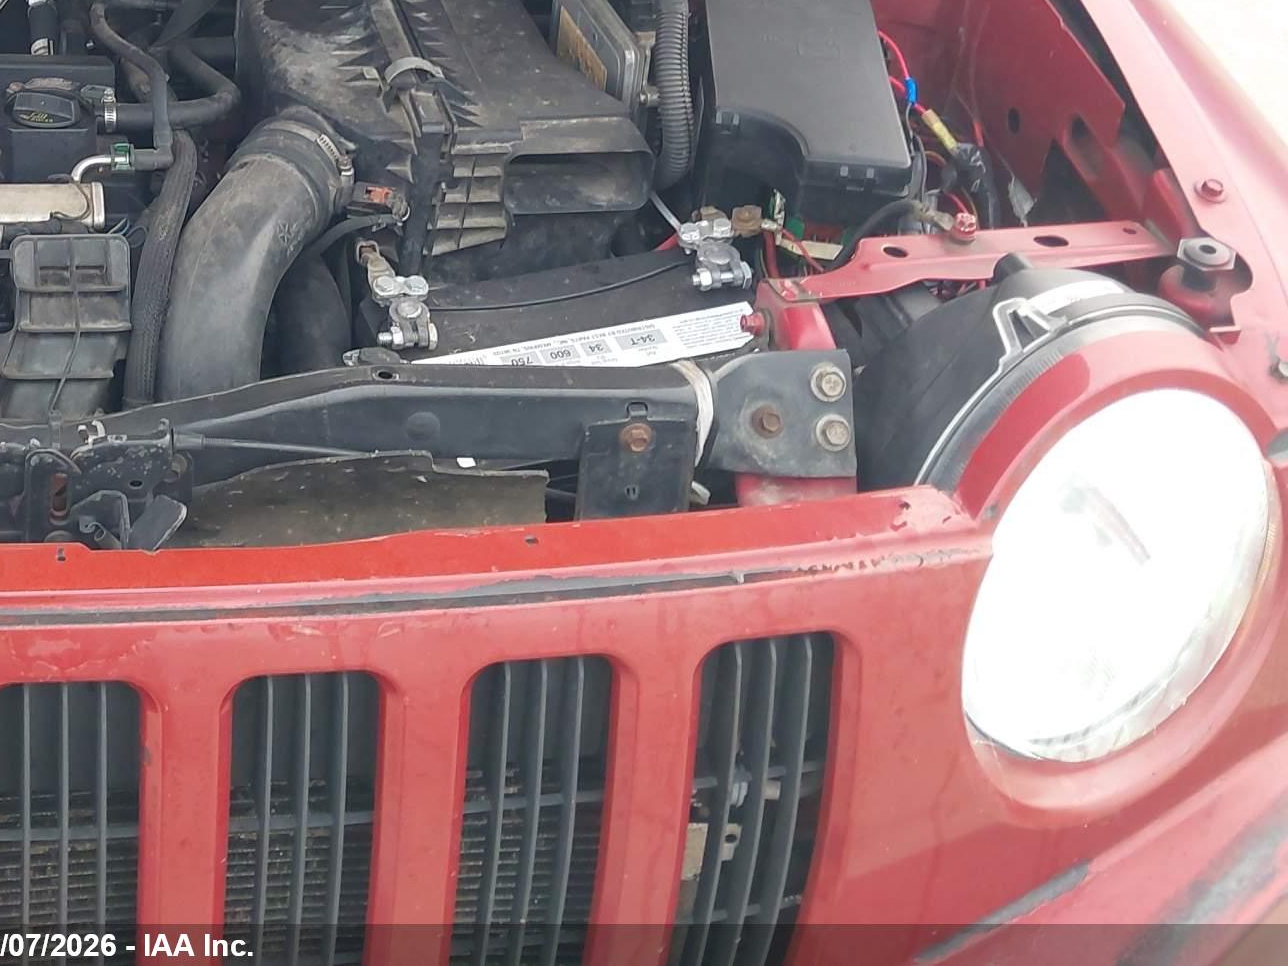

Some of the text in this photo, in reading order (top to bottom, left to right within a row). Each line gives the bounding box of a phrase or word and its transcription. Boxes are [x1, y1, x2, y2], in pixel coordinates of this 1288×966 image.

[511, 333, 656, 366] 34-T 34 600 750
